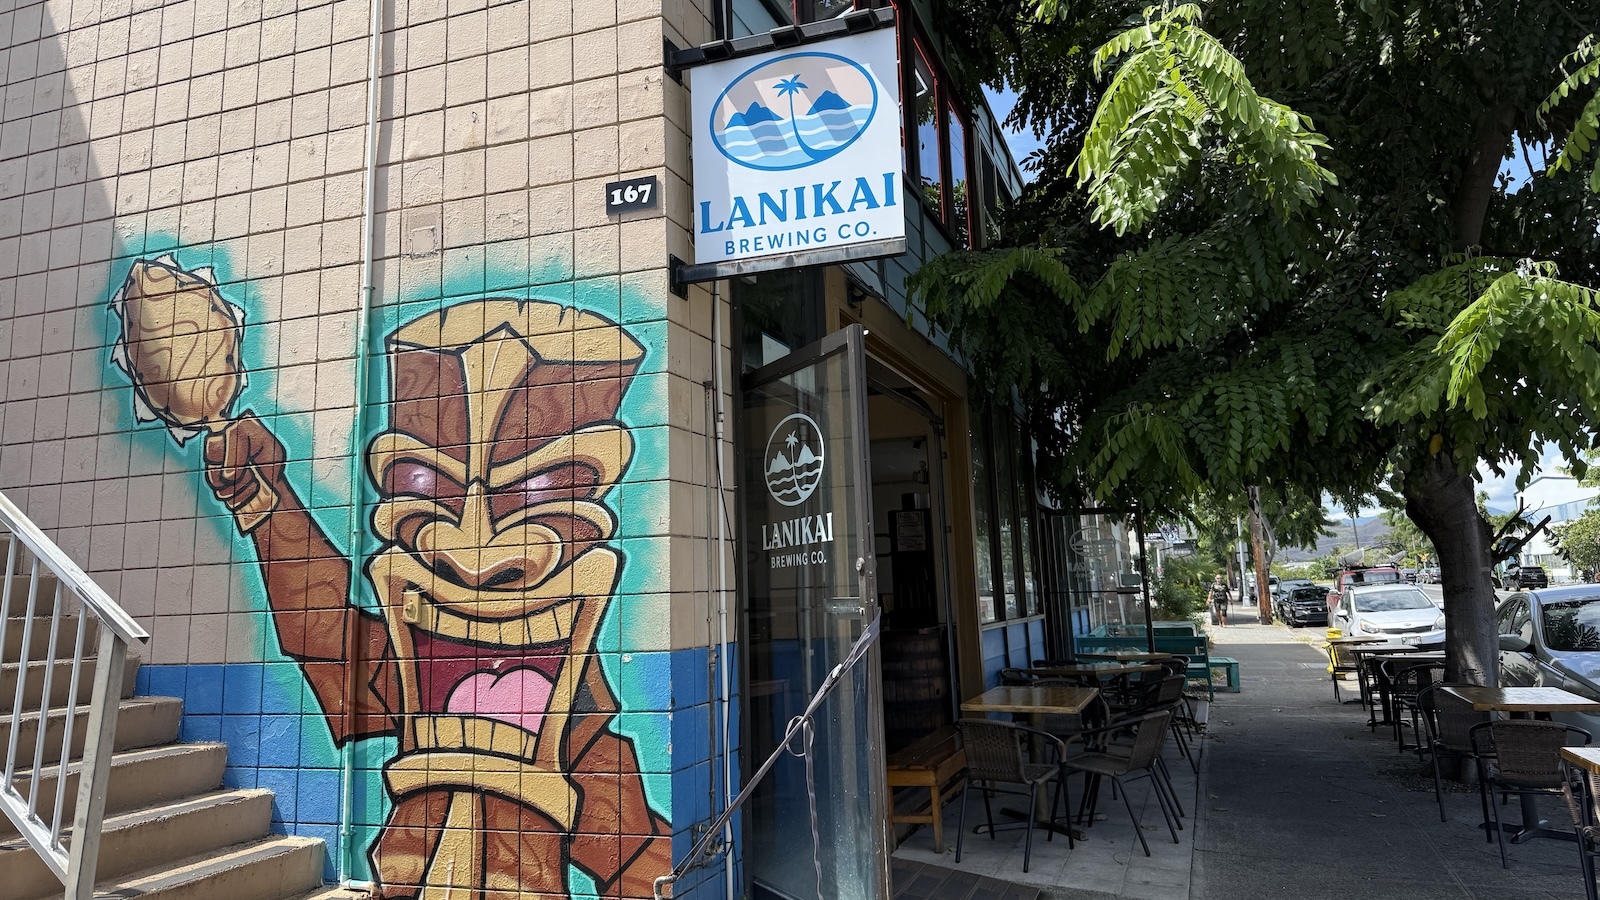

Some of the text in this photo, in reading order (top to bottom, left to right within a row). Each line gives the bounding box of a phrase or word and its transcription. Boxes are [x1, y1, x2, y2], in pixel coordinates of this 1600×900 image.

[610, 184, 652, 206] 167
[700, 172, 897, 234] LANIKAI
[725, 221, 877, 256] BREWING CO.
[762, 512, 834, 550] LANIKAI
[771, 550, 827, 569] BREWING CO.
